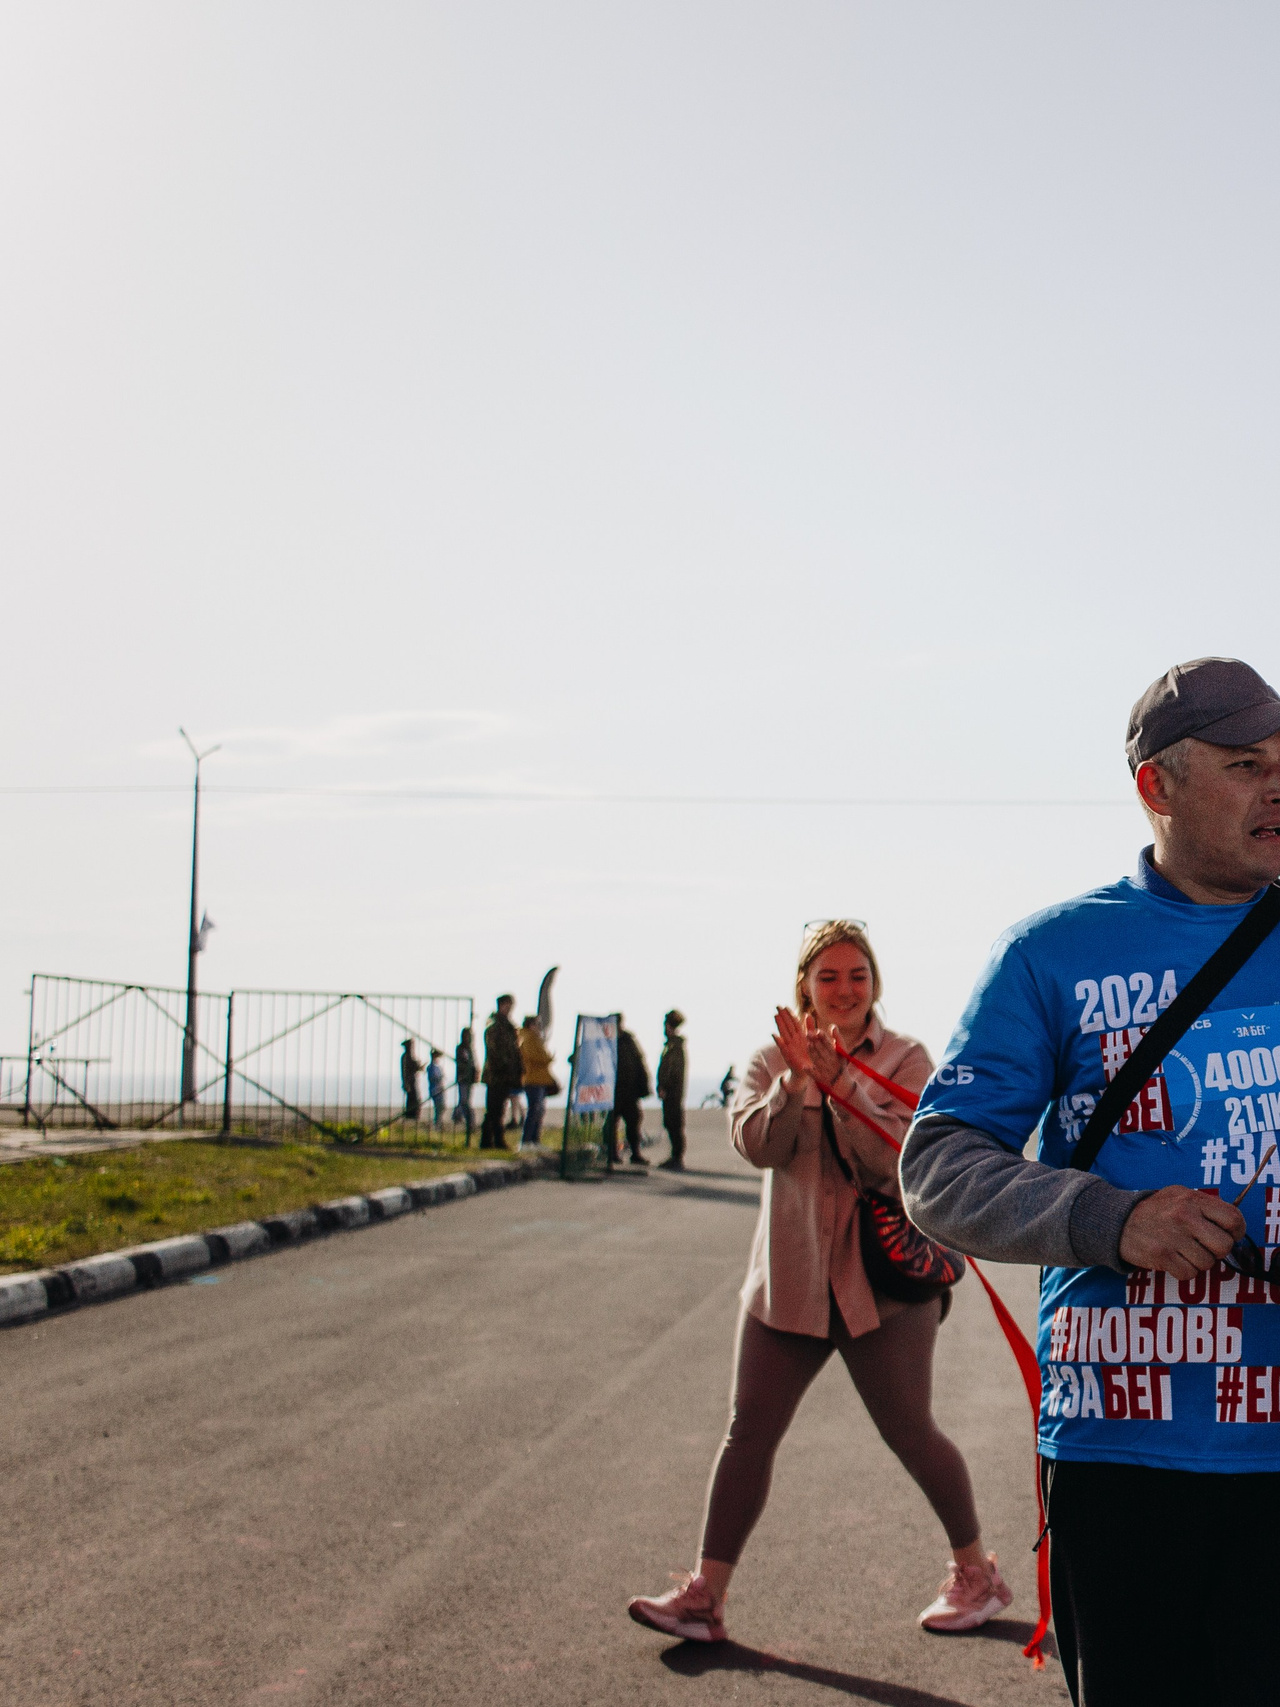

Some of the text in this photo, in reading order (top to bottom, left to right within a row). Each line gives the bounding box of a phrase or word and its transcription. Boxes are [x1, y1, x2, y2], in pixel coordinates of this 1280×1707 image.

[1075, 969, 1178, 1034] 2024
[1051, 1307, 1243, 1364] #ЛЮБОВЬ
[1048, 1365, 1172, 1420] #ЗАБЕГ
